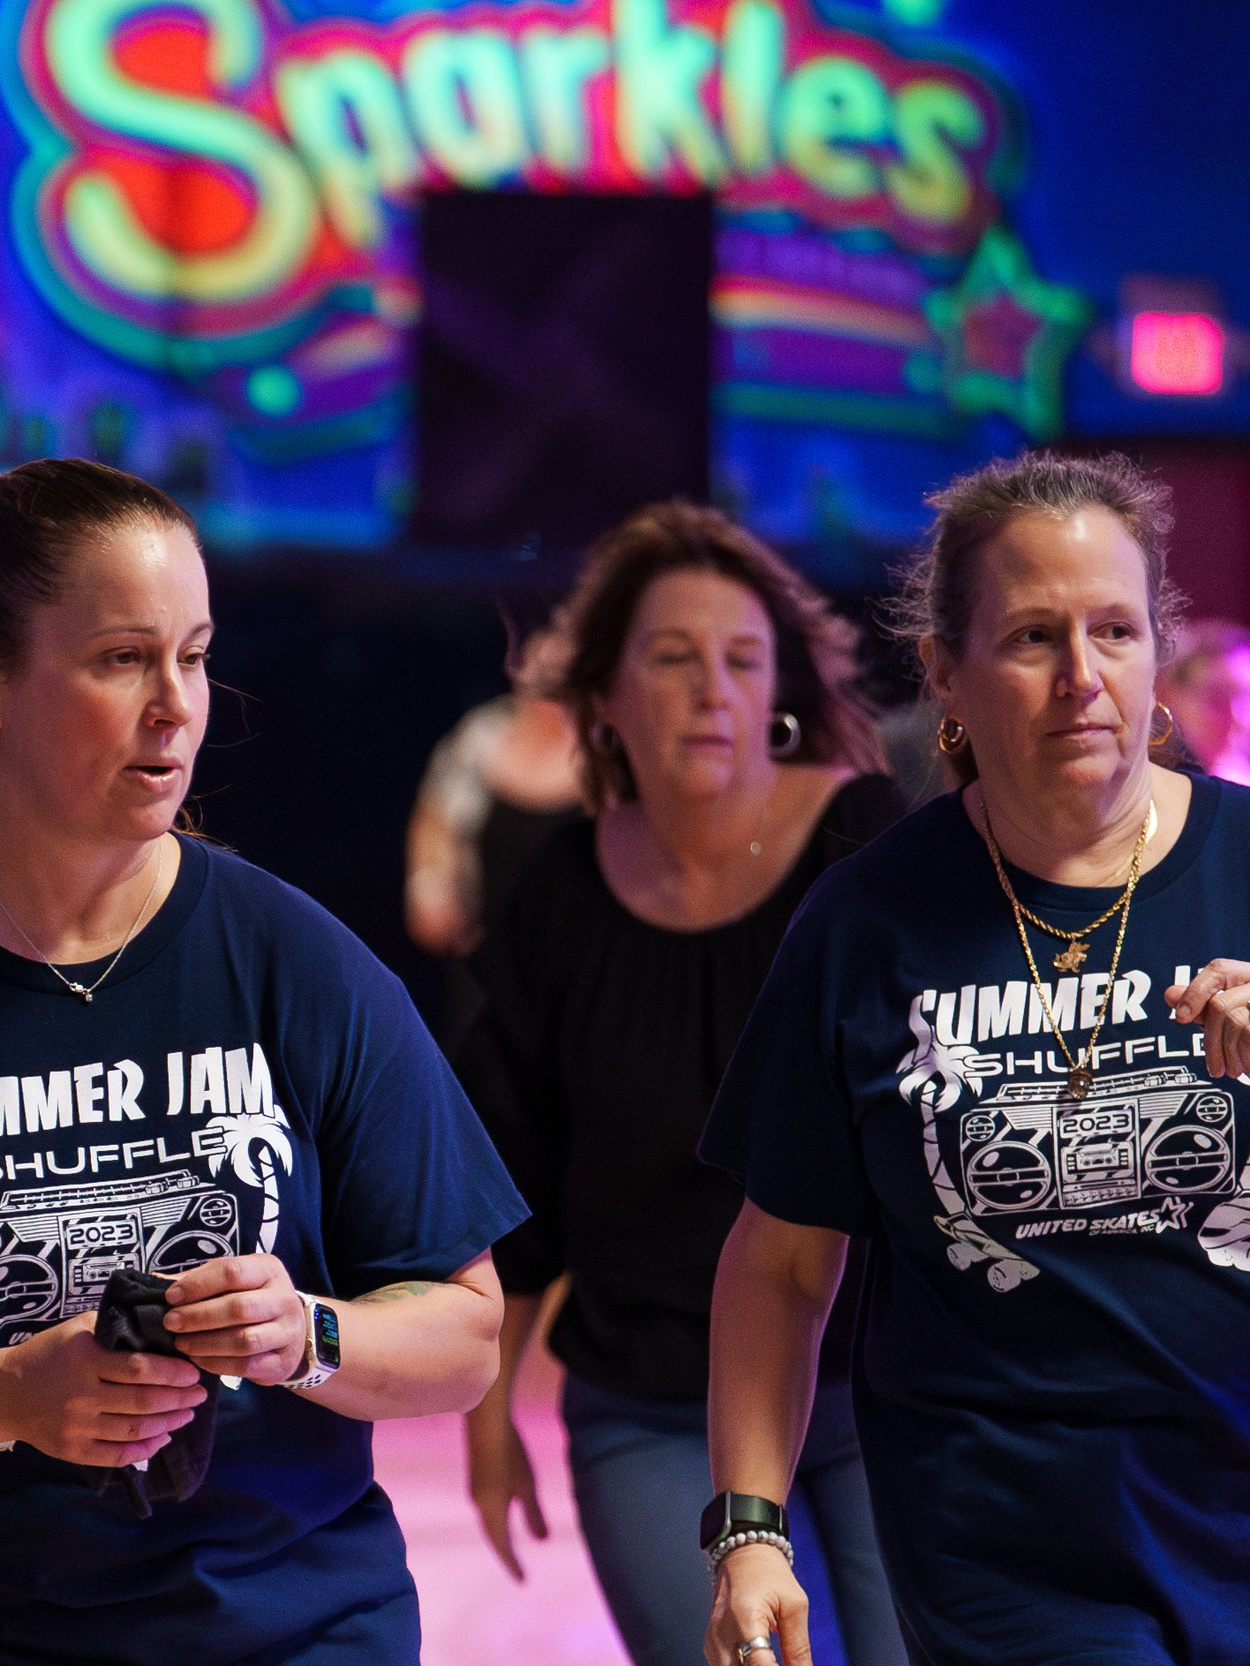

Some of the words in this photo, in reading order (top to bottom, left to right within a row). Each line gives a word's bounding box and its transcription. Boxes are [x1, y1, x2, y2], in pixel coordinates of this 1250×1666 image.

[42, 0, 990, 306] Sparkles
[166, 1042, 276, 1119] JAM
[1062, 1113, 1130, 1133] 2023
[68, 1223, 135, 1245] 2023
[1015, 1218, 1087, 1239] UNITED
[1089, 1208, 1161, 1230] SKATES
